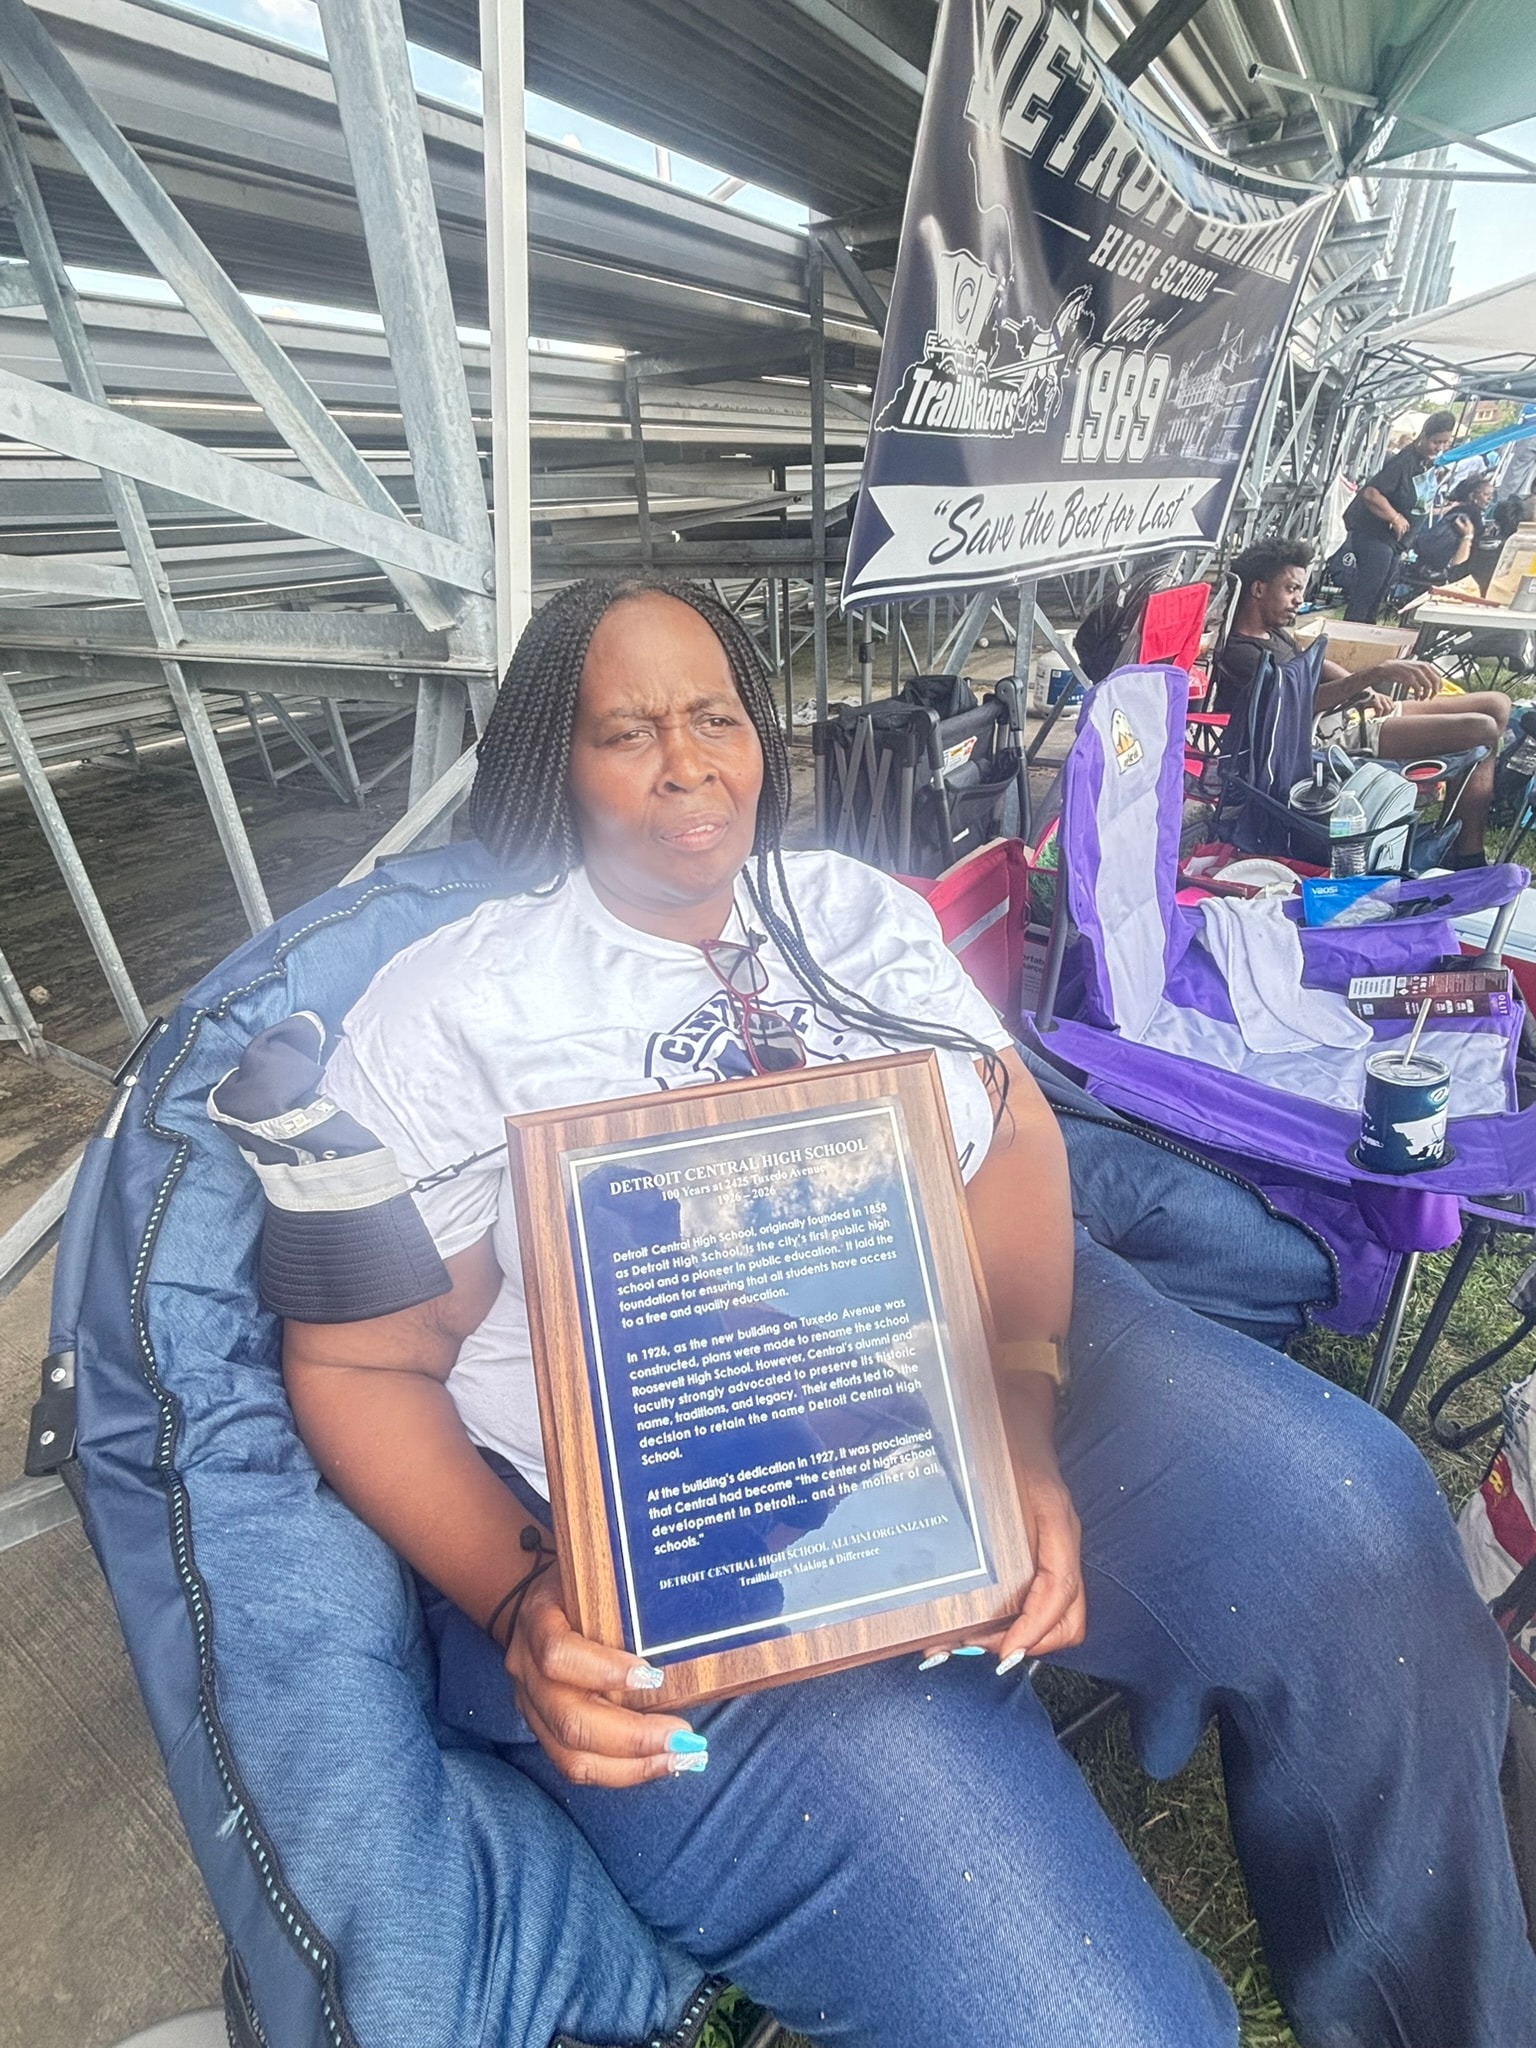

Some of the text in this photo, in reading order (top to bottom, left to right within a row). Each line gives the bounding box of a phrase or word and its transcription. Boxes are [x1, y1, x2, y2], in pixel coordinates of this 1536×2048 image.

[1088, 224, 1218, 303] HIGH SCHOOL
[956, 277, 976, 323] C
[1102, 293, 1183, 354] Class of
[1061, 342, 1171, 463] 1989
[1020, 490, 1055, 549] the
[1058, 486, 1104, 548] Best
[1102, 491, 1136, 548] for
[609, 1138, 867, 1194] DETROIT CENTRAL HIGH SCHOOL
[661, 1165, 824, 1200] 100 Years at 2425 Tuxedo Avenue
[718, 1192, 741, 1204] 1926
[751, 1186, 775, 1198] 2026
[612, 1202, 887, 1262] Detroit Central High School, originally founded in 1858
[615, 1269, 629, 1278] as
[631, 1259, 669, 1275] Detroit
[672, 1254, 698, 1267] High
[701, 1246, 743, 1262] School,
[744, 1244, 754, 1253] is
[756, 1241, 774, 1251] the
[809, 1229, 828, 1241] first
[831, 1224, 865, 1239] public
[867, 1218, 890, 1231] high
[617, 1279, 654, 1294] school
[656, 1274, 679, 1287] and
[691, 1266, 733, 1283] pioneer
[735, 1263, 745, 1272] in
[748, 1256, 781, 1272] public
[784, 1246, 840, 1262] education.
[846, 1241, 854, 1251] It
[854, 1237, 875, 1249] laid
[876, 1235, 892, 1245] the
[619, 1251, 896, 1311] foundation for ensuring that all students have access
[621, 1289, 788, 1328] to a free and quality education.
[626, 1300, 905, 1362] In 1926, as the new building on Tuxedo Avenue was
[629, 1313, 909, 1379] constructed, plans were made to rename the school
[631, 1376, 684, 1396] Roosevelt
[686, 1370, 712, 1385] High
[713, 1363, 753, 1379] School.
[755, 1355, 805, 1370] However,
[855, 1334, 890, 1350] alumni
[892, 1330, 912, 1342] and
[633, 1347, 914, 1413] faculty strongly advocated to preserve its historic
[636, 1363, 919, 1430] name, traditions, and legacy. Their efforts led to the
[638, 1378, 921, 1447] decision to retain the name Detroit Central High
[641, 1448, 682, 1465] School.
[646, 1489, 660, 1501] At
[661, 1486, 679, 1498] the
[736, 1462, 795, 1481] dedication
[797, 1458, 807, 1468] in
[810, 1450, 838, 1465] 1927,
[839, 1448, 846, 1458] it
[848, 1445, 870, 1456] was
[871, 1429, 932, 1454] proclaimed
[648, 1504, 672, 1518] that
[674, 1494, 717, 1513] Central
[719, 1488, 742, 1503] had
[744, 1480, 791, 1497] become
[821, 1465, 857, 1480] center
[859, 1460, 871, 1471] of
[872, 1454, 898, 1469] high
[899, 1446, 935, 1462] school
[651, 1508, 736, 1536] development
[739, 1506, 750, 1517] in
[811, 1486, 835, 1500] and
[838, 1483, 856, 1494] the
[862, 1473, 903, 1489] mother
[908, 1467, 919, 1478] of
[923, 1463, 937, 1475] all
[659, 1513, 948, 1589] DETROIT CENTRAL HIGH SCHOOL ALUMNI ORGANIZATION
[738, 1568, 792, 1587] Trailblazers
[793, 1560, 827, 1574] Making
[835, 1548, 880, 1564] Difference
